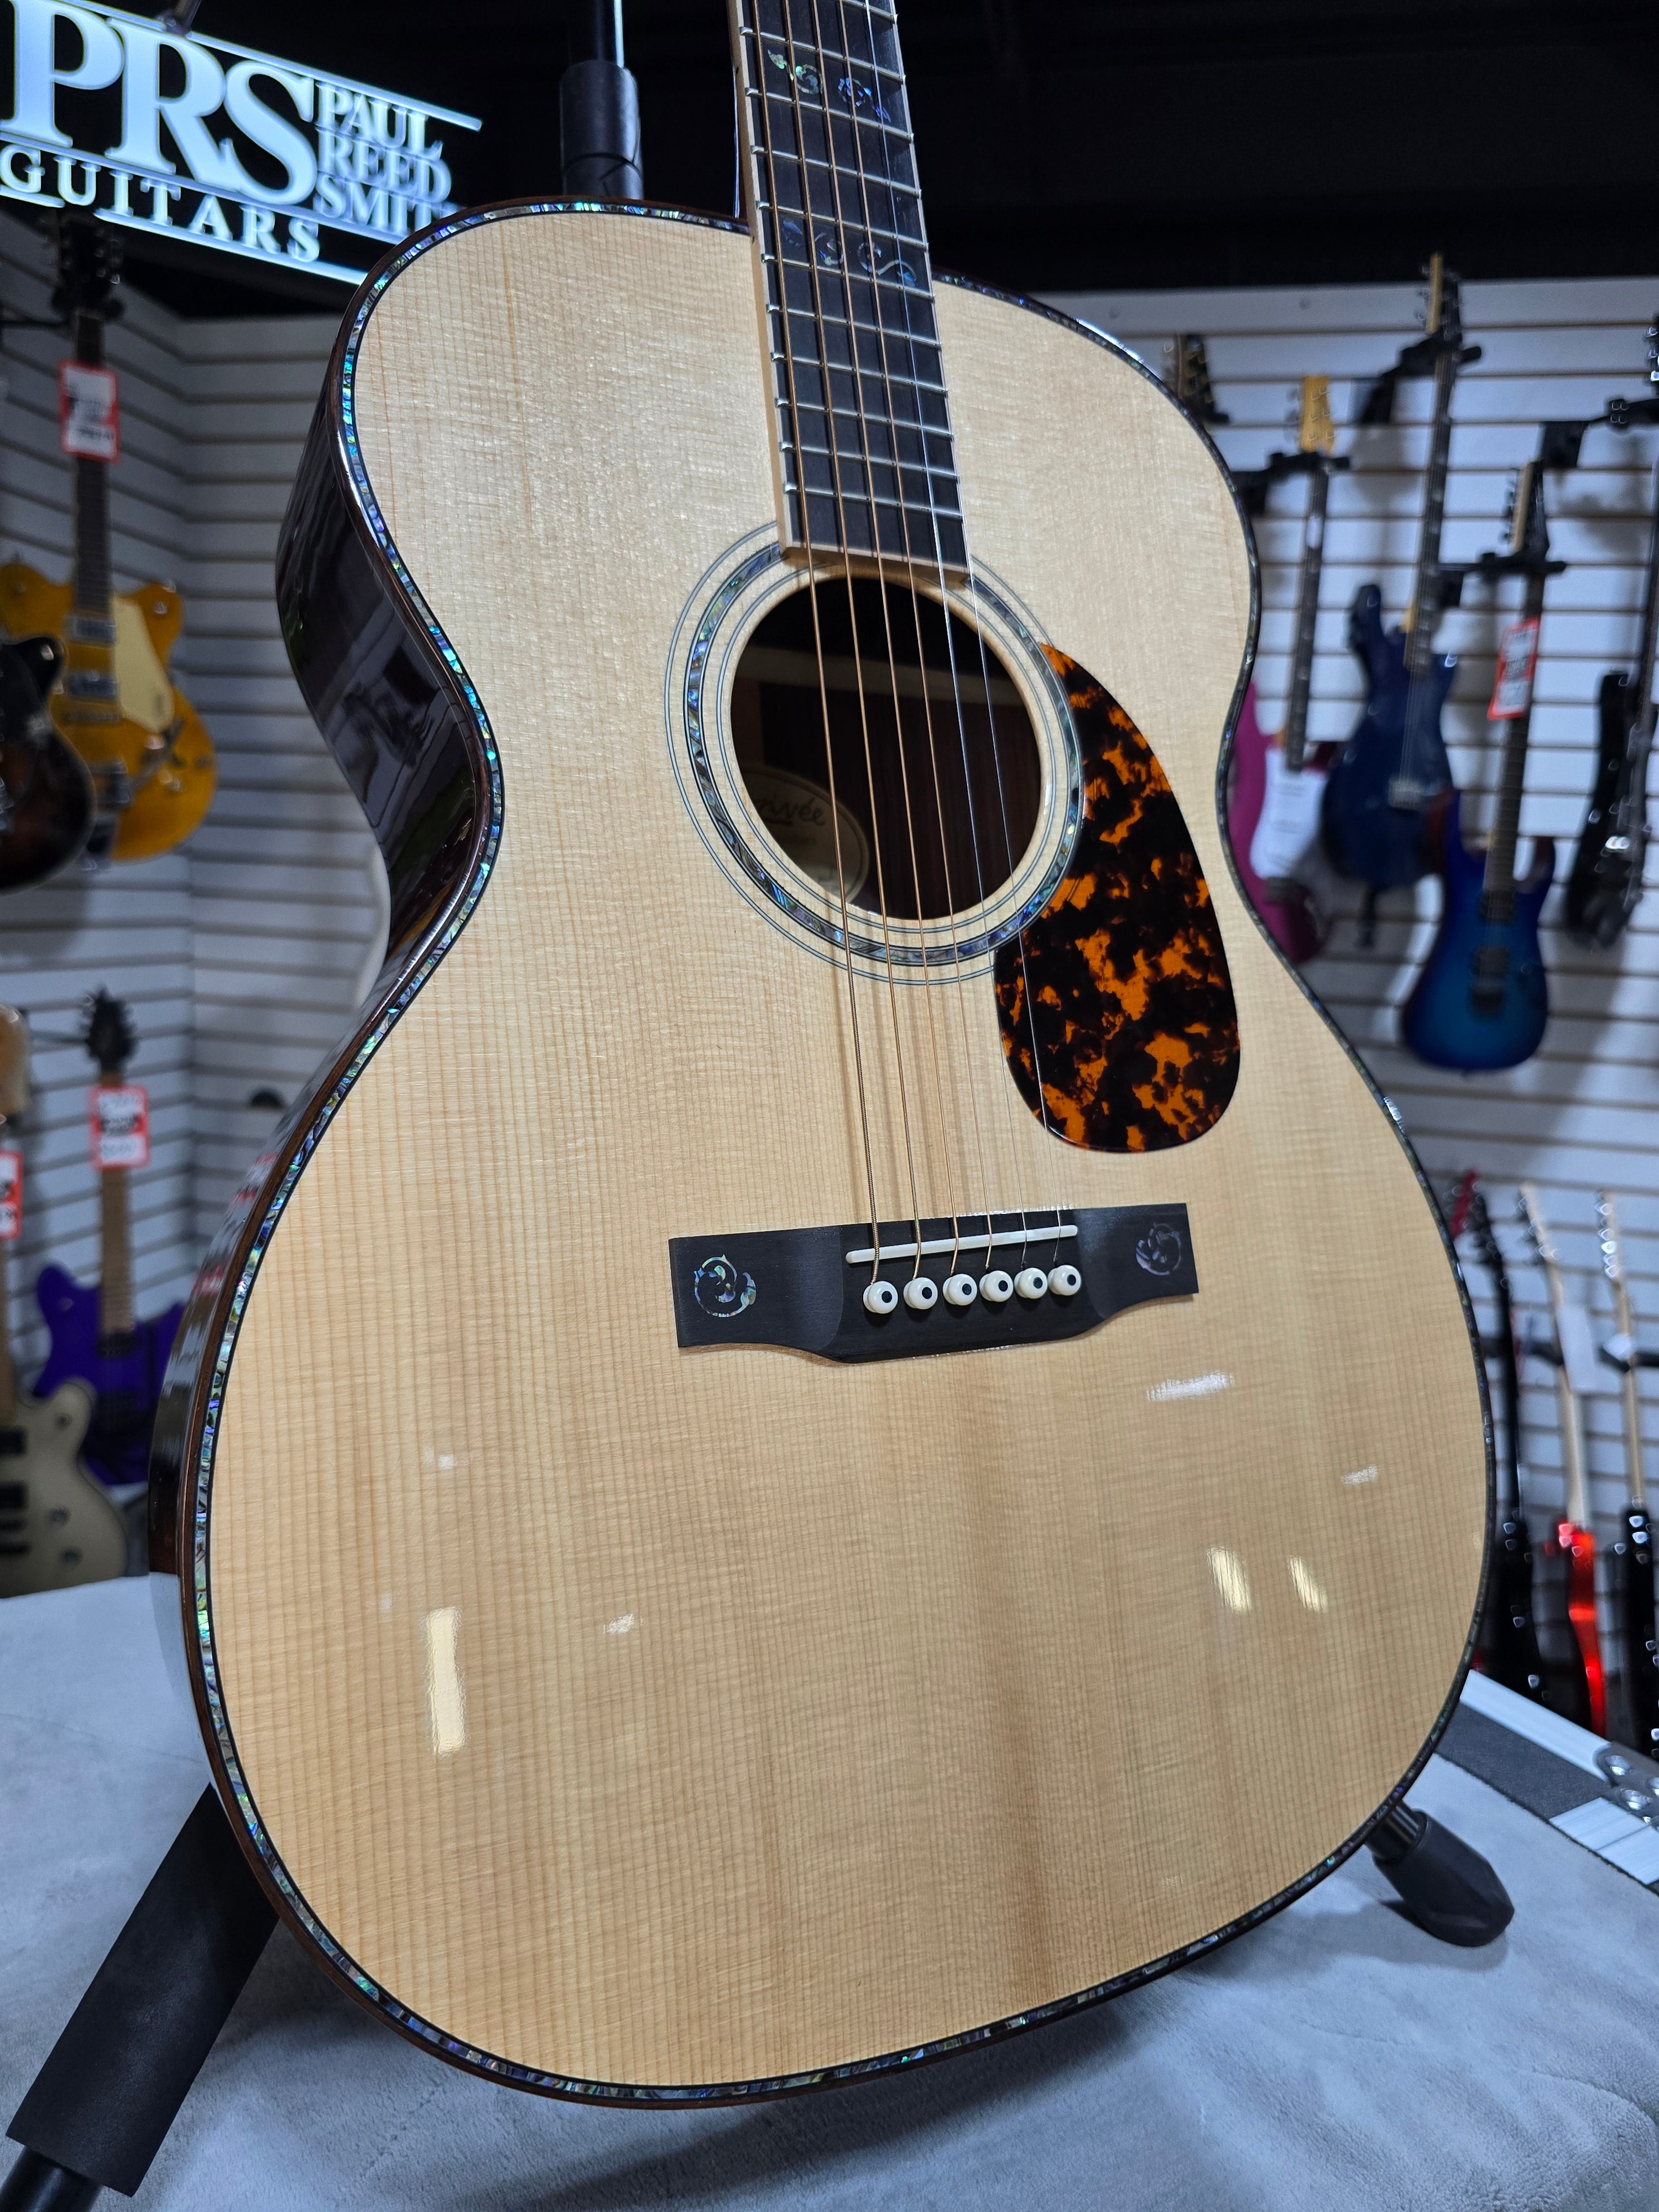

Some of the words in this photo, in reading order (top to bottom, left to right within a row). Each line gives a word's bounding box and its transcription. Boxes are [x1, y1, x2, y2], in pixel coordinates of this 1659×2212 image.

[0, 0, 317, 205] PRS
[315, 83, 443, 160] PAUL
[313, 171, 467, 236] SMIT
[315, 127, 452, 203] REED
[0, 145, 320, 263] GUITARS
